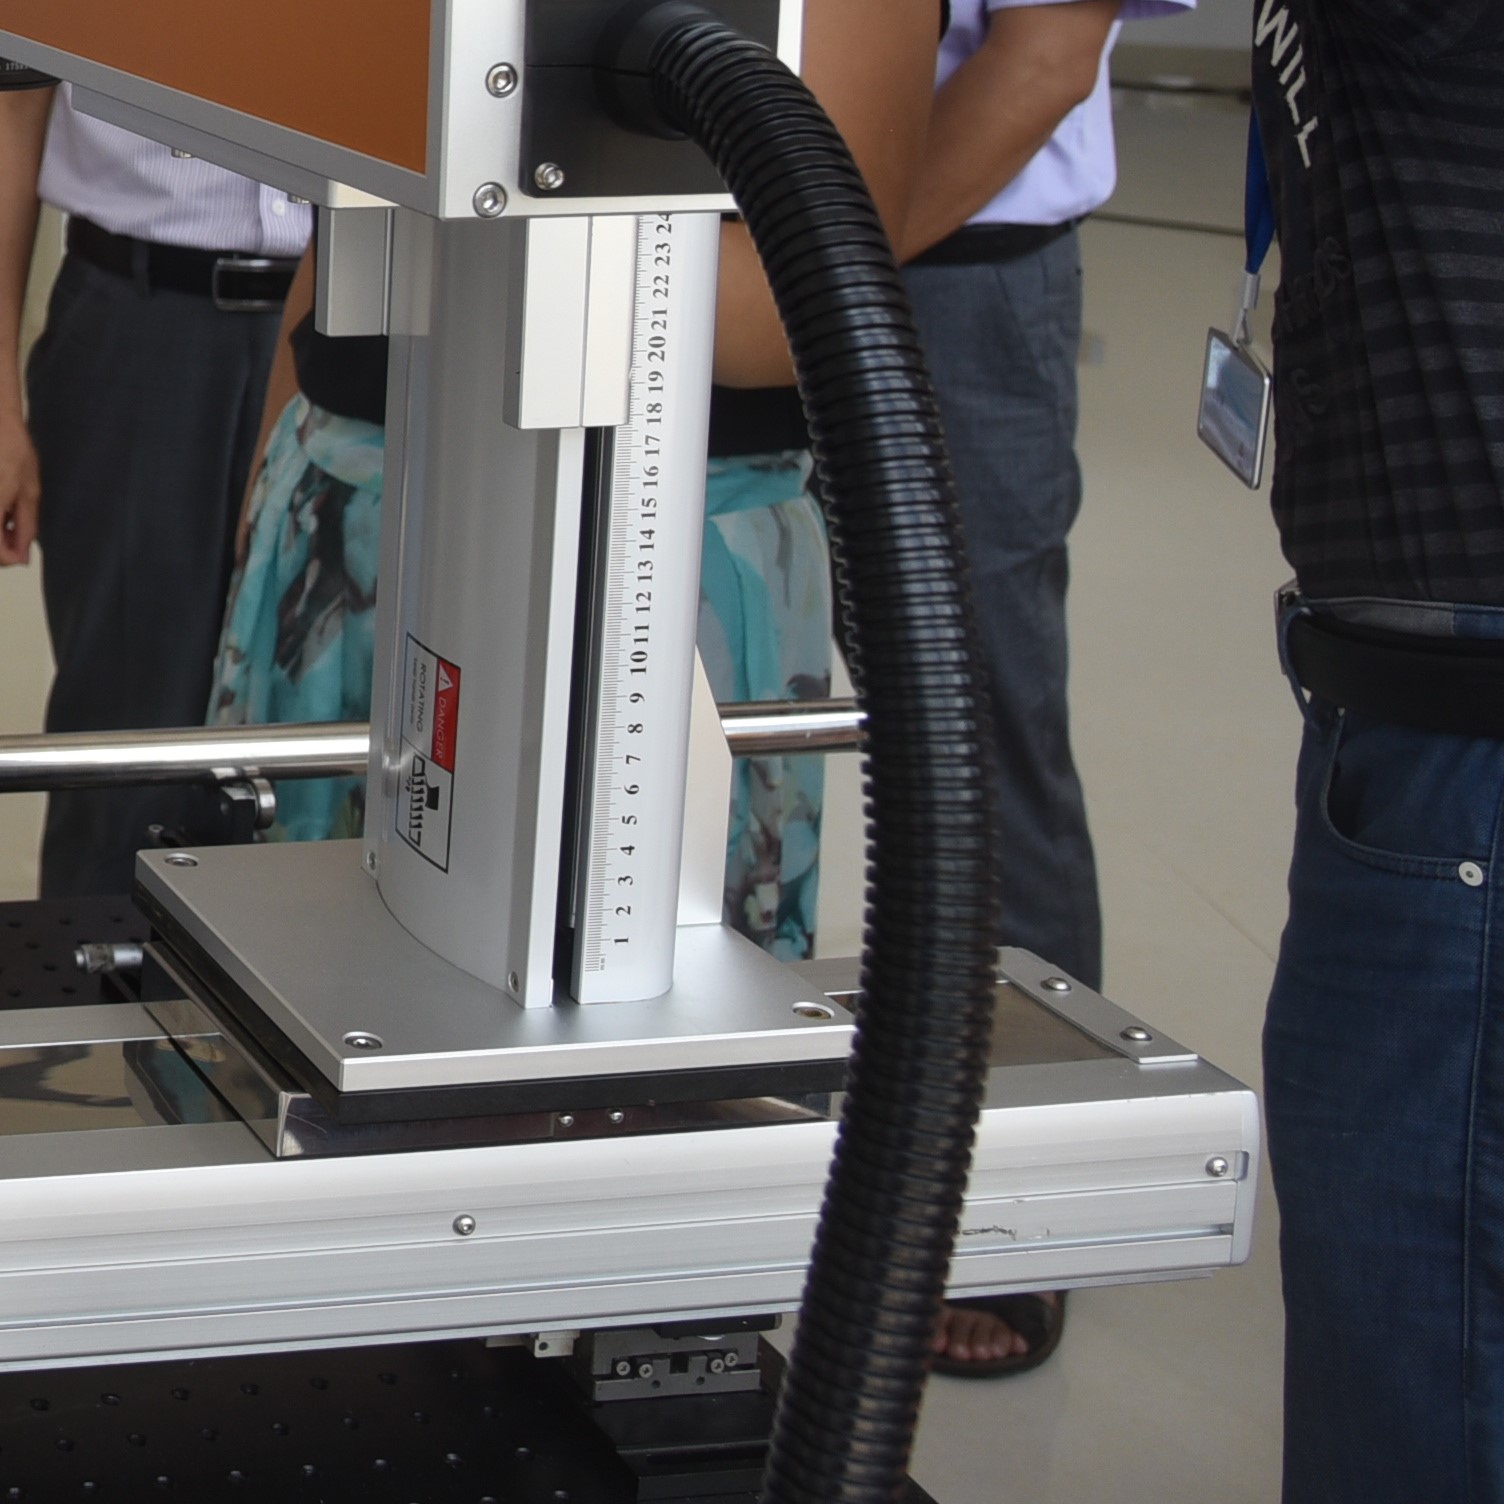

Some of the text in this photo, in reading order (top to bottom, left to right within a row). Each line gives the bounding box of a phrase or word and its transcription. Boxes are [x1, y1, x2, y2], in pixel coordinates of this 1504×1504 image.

[655, 242, 671, 267] 23
[653, 274, 670, 299] 22
[651, 307, 668, 331] 21
[648, 334, 666, 363] 20
[648, 370, 665, 394] 19
[646, 402, 663, 425] 18
[645, 434, 661, 457] 17
[643, 465, 660, 489] 16
[641, 497, 658, 521] 15
[639, 528, 656, 551] 14
[637, 559, 654, 583] 13
[635, 591, 652, 614] 12
[633, 622, 650, 645] 11
[629, 650, 648, 676] 10
[629, 691, 646, 704] 9
[434, 697, 447, 759] DANGER
[627, 722, 644, 735] 8
[625, 753, 642, 766] 7
[623, 783, 641, 795] 6
[621, 814, 638, 826] 5
[619, 845, 636, 857] 4
[617, 874, 634, 887] 3
[615, 904, 632, 916] 2
[613, 936, 630, 945] 1
